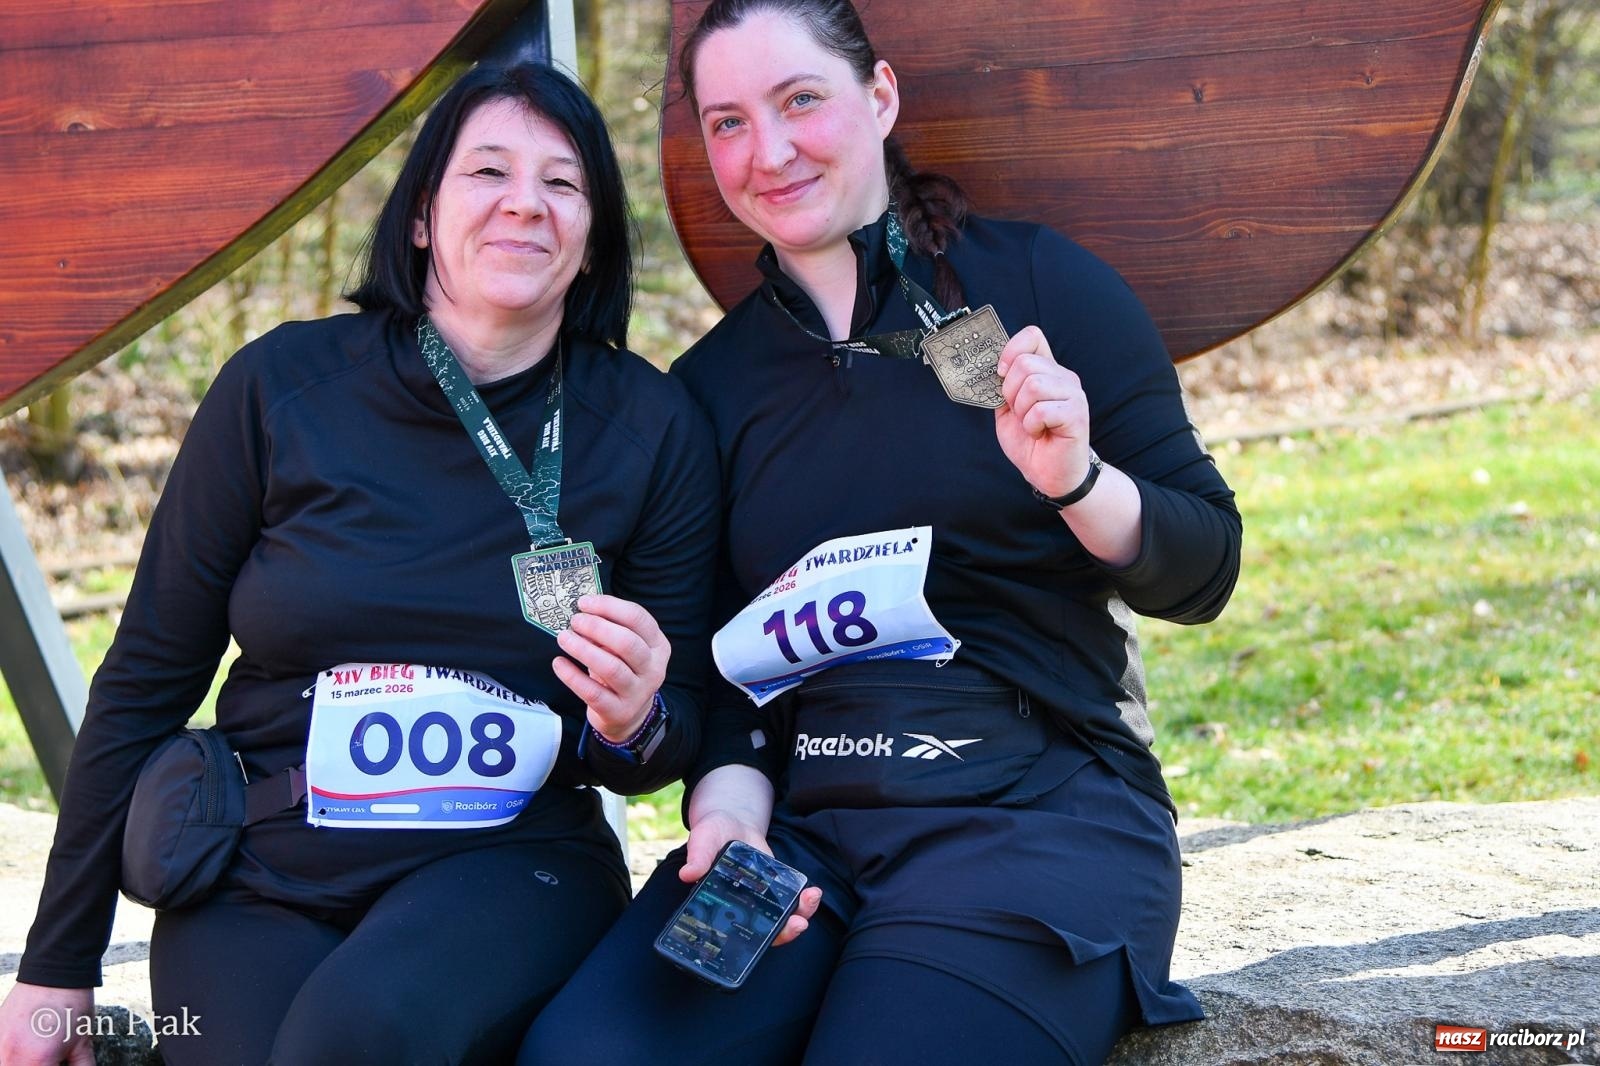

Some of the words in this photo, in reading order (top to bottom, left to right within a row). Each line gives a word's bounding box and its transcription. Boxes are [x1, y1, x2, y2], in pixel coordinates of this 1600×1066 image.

[477, 429, 492, 446] BIEG
[482, 416, 512, 460] TWARDZIELA
[485, 444, 499, 458] XIV
[528, 555, 602, 575] TWARDZIELA
[537, 553, 558, 564] XIV
[560, 548, 585, 560] BIEG
[804, 541, 914, 572] TWARDZIELA
[774, 580, 796, 595] 2026
[763, 590, 878, 665] 118
[331, 690, 342, 699] 15
[344, 686, 382, 698] marzec
[384, 684, 414, 694] 2026
[333, 668, 363, 686] XIV
[370, 664, 415, 681] BIEG
[425, 665, 533, 707] TWARDZIELA
[350, 711, 516, 778] 008
[795, 733, 895, 760] Reebok
[455, 801, 498, 810] Racibórz
